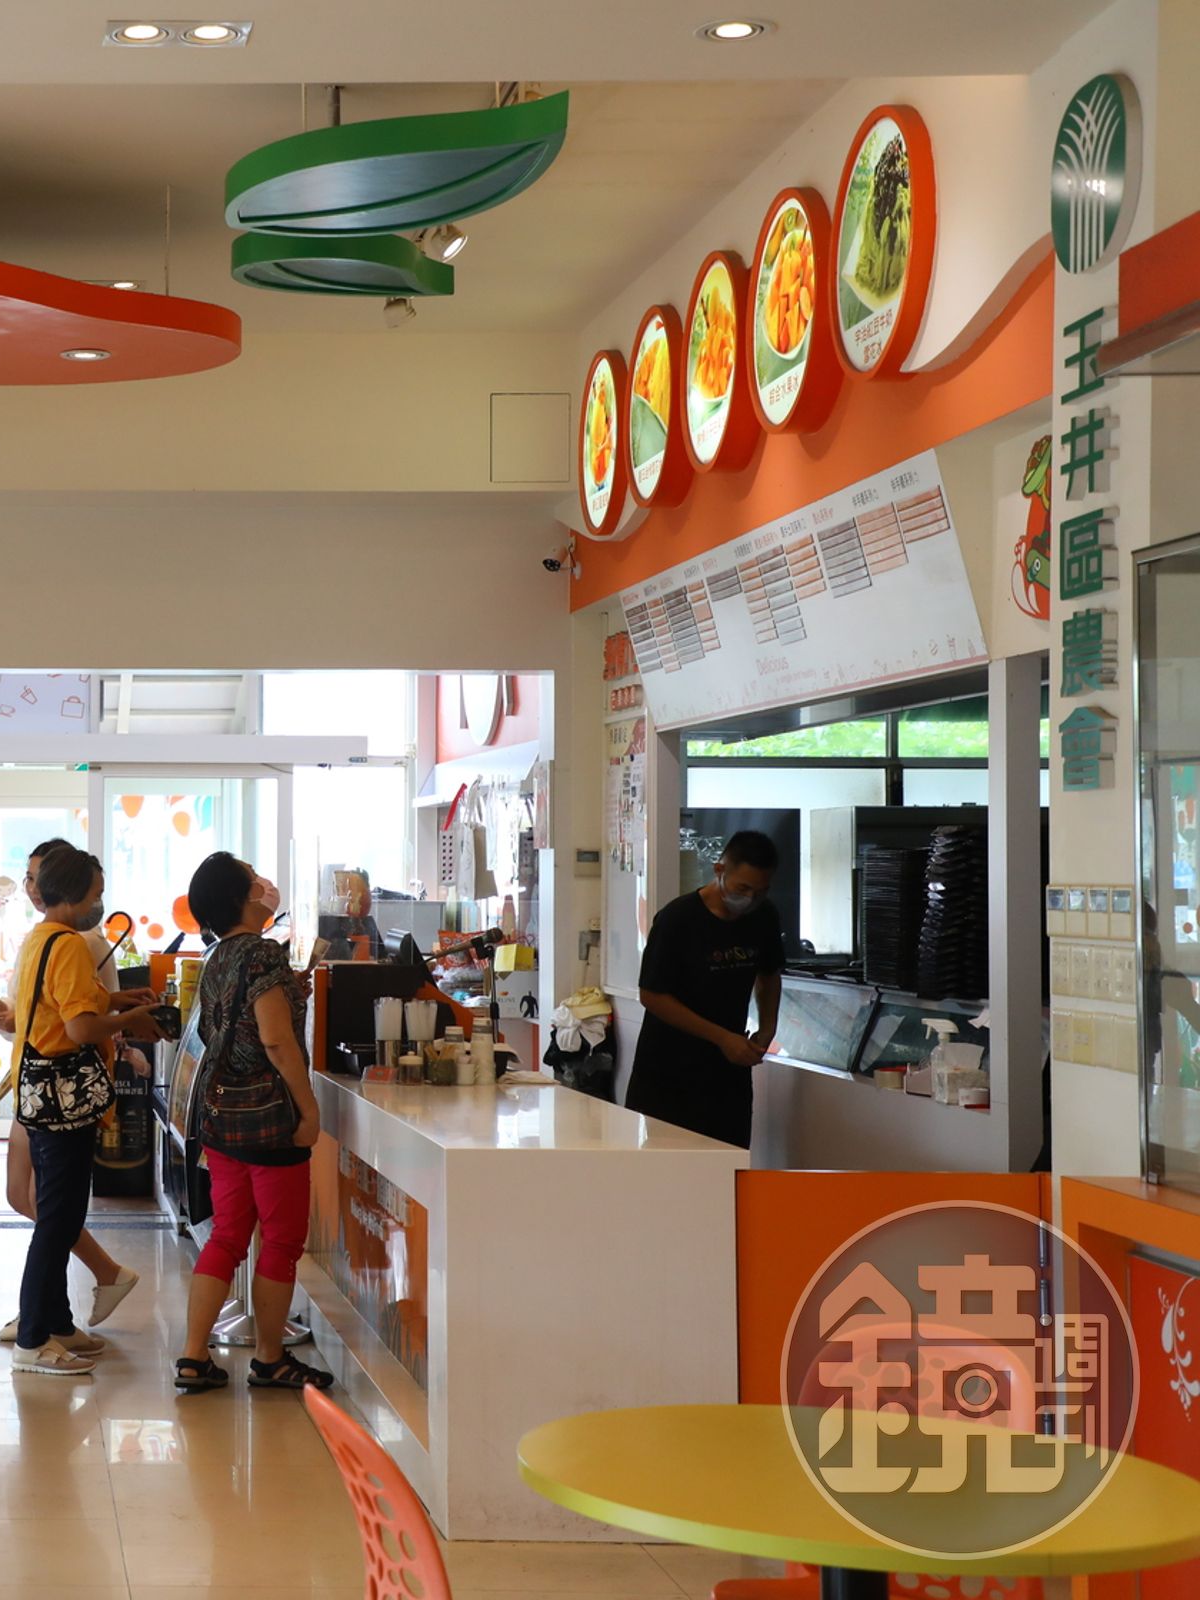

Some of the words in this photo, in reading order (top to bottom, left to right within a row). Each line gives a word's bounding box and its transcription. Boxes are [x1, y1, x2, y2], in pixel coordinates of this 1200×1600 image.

[1059, 307, 1105, 792] 玉井區農會
